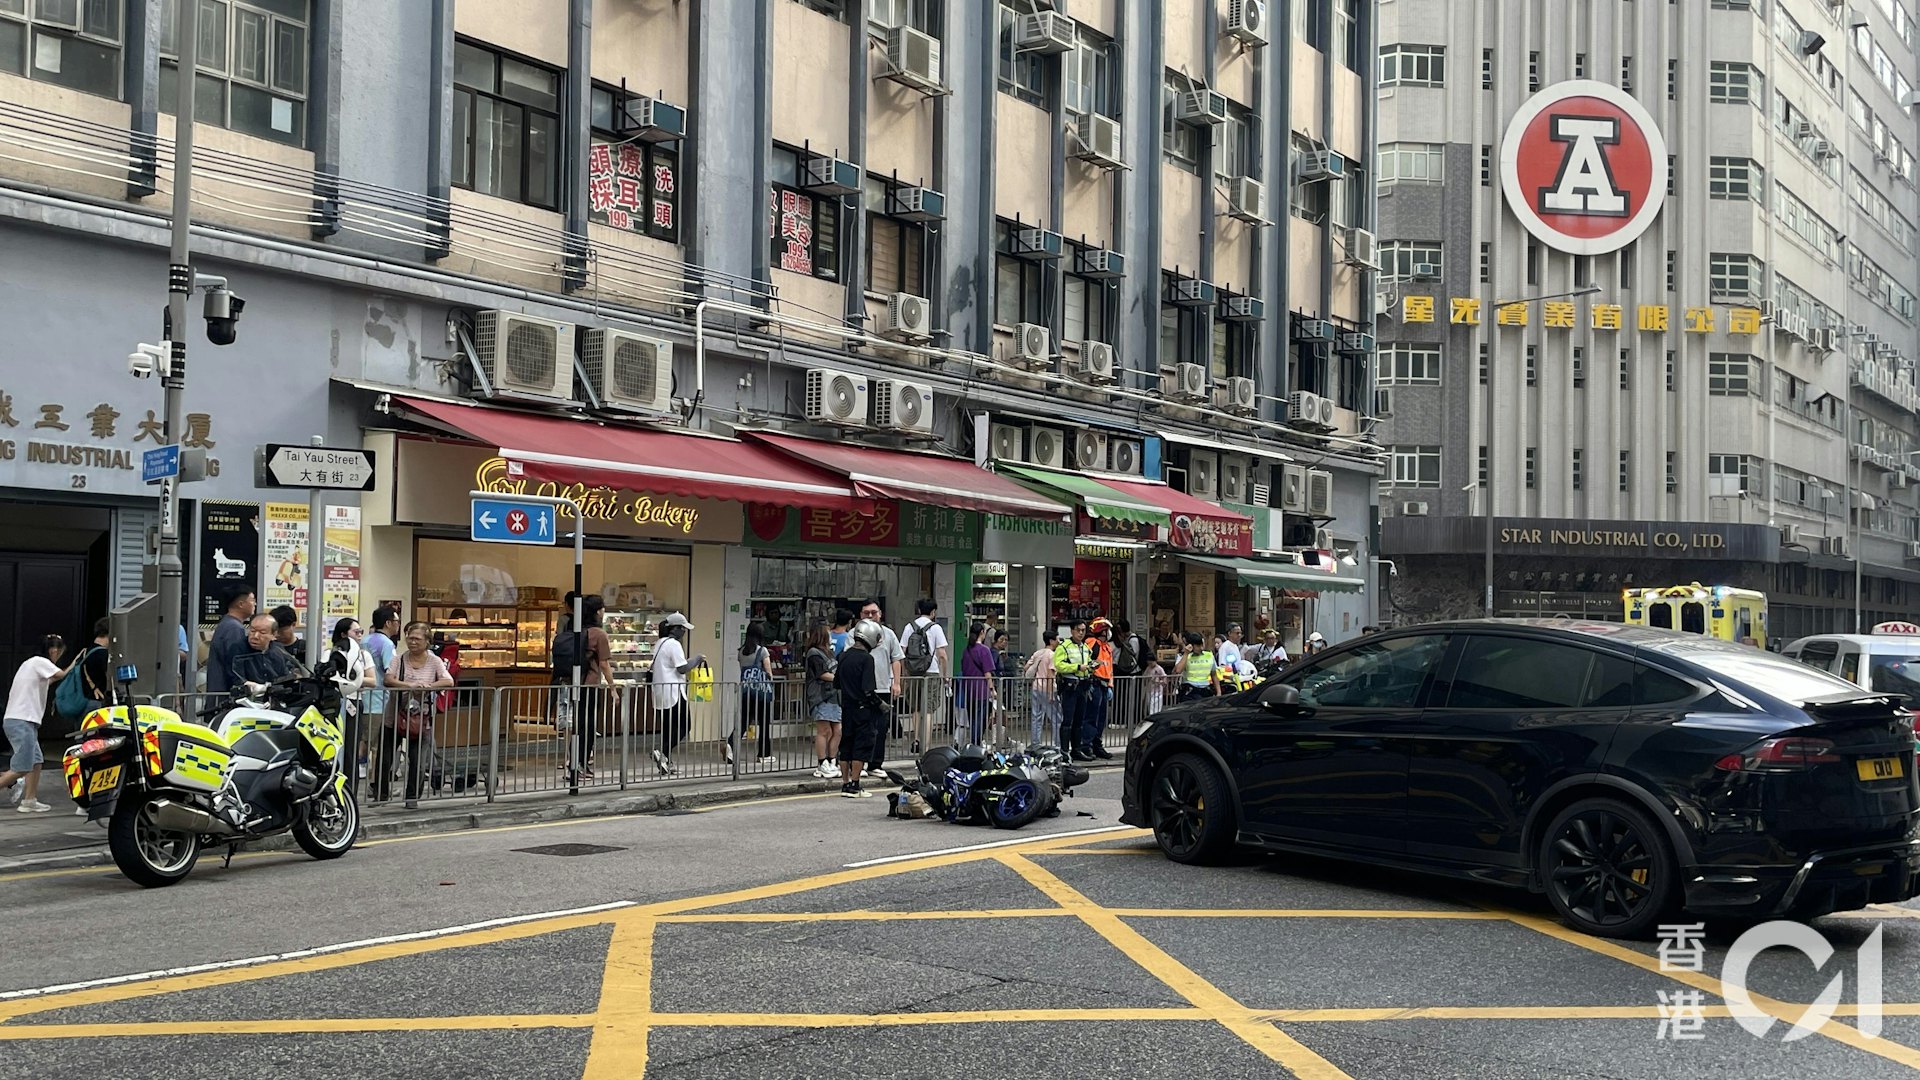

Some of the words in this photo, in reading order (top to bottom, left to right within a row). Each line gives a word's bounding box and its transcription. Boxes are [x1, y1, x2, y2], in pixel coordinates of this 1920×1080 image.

[1541, 116, 1628, 215] A
[655, 167, 673, 225] 洗頭
[27, 442, 134, 470] INDUSTRIAL
[284, 450, 300, 461] Tai
[304, 452, 324, 463] Yau
[327, 453, 359, 465] Street
[72, 475, 86, 489] 23
[300, 469, 343, 484] 大有街
[634, 496, 699, 533] Bakery
[913, 506, 966, 532] 折扣倉
[1500, 528, 1542, 544] STAR
[1551, 530, 1648, 547] INDUSTRIAL
[1693, 533, 1726, 548] LTD.
[1881, 623, 1917, 634] TAXI
[91, 777, 117, 788] 7454
